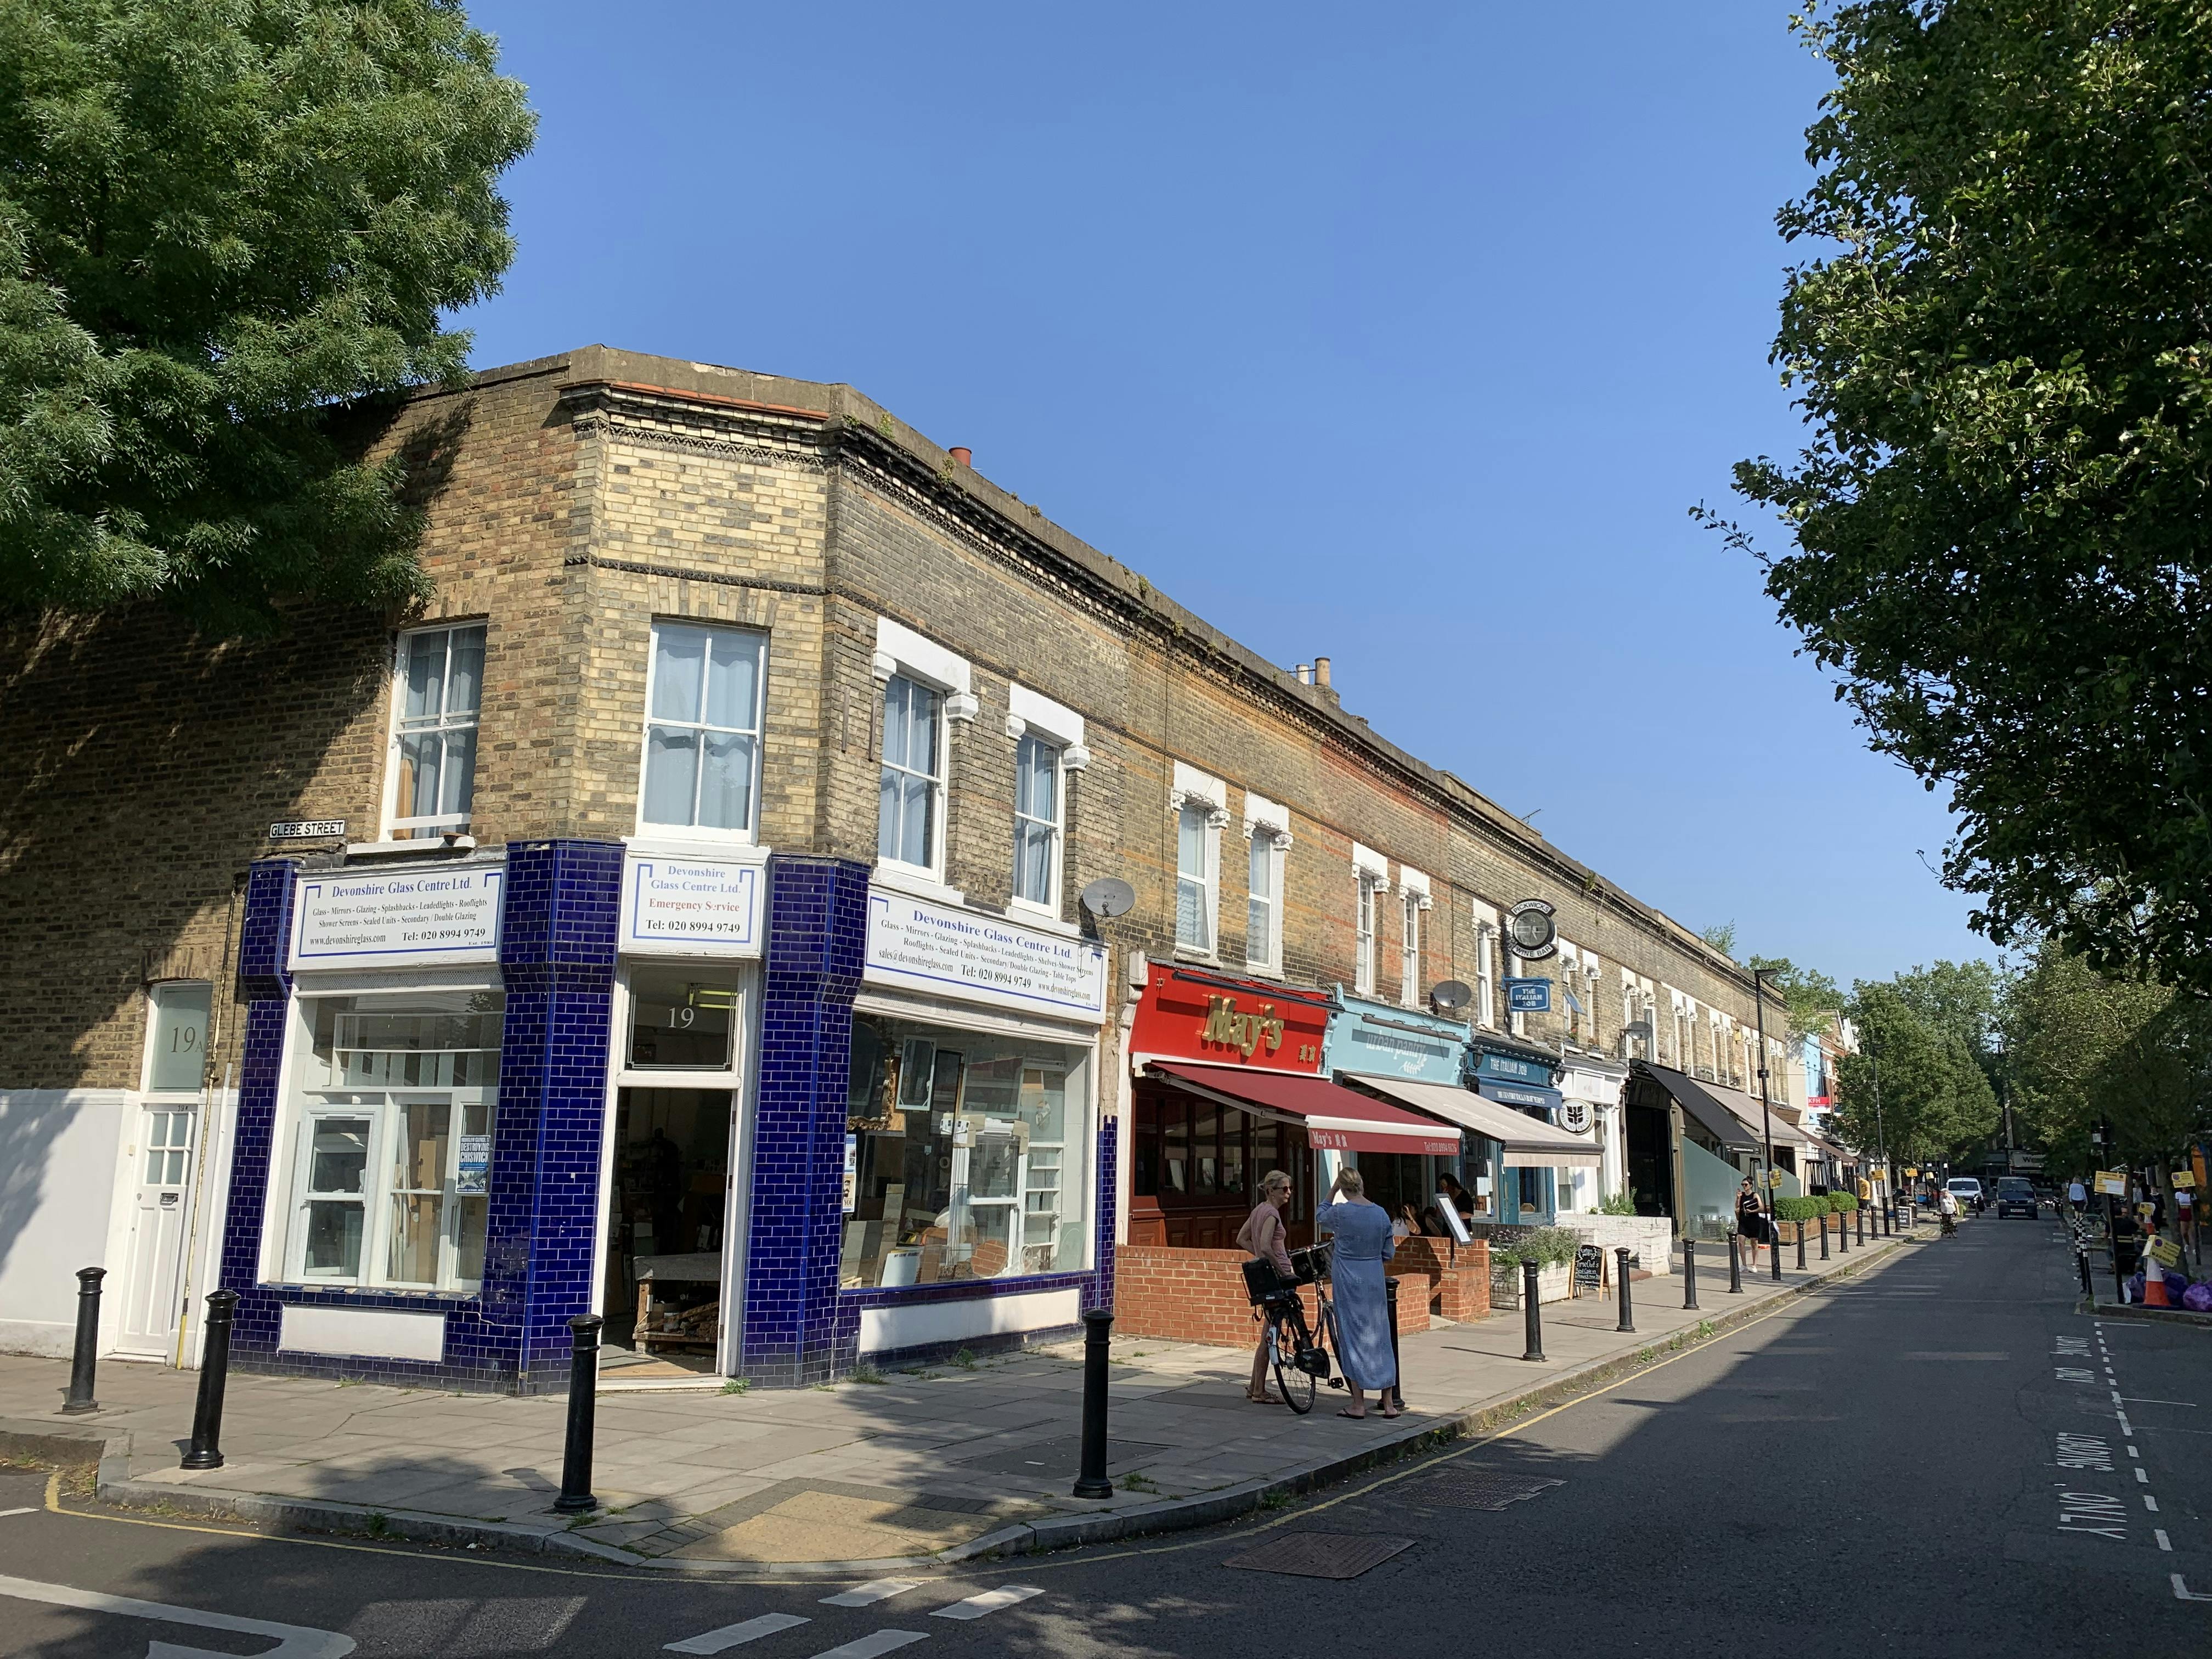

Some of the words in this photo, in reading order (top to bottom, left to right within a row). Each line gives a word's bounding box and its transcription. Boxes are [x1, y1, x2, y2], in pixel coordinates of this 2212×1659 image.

[272, 824, 302, 836] GLEBE
[304, 822, 343, 834] STREET
[668, 865, 725, 878] Devonshire
[332, 883, 385, 898] Devonshire
[388, 882, 414, 894] Glass
[417, 879, 450, 892] Centre
[452, 877, 472, 890] Ltd.
[651, 879, 679, 890] Glass
[682, 881, 717, 892] Centre
[720, 883, 741, 893] Ltd.
[313, 908, 326, 916] Glass
[356, 905, 376, 914] Glazing
[381, 902, 415, 914] Splashbacks
[420, 900, 454, 910] Leadedlights
[459, 898, 487, 908] Rooflights
[649, 898, 703, 912] Emergency
[705, 901, 740, 912] Service
[1513, 902, 1550, 913] PICKWICKS
[401, 915, 428, 924] Secondary
[434, 913, 453, 921] Double
[455, 911, 476, 921] Glazing
[646, 919, 664, 930] Tel:
[668, 921, 686, 930] 020
[690, 922, 713, 932] 8994
[716, 923, 740, 933] 9749
[310, 934, 386, 946] www.devonshireglass.com
[402, 932, 418, 941] Tel:
[421, 930, 437, 940] 020
[439, 929, 461, 939] 8994
[464, 928, 486, 937] 9749
[913, 910, 980, 936] Devonshire
[984, 928, 1013, 944] Glass
[1017, 936, 1051, 953] Centre
[1054, 945, 1072, 959] Ltd.
[881, 919, 899, 930] Glass
[906, 925, 929, 938] Mirrors
[935, 932, 957, 945] Glazing
[963, 939, 997, 953] Splashbacks
[1002, 947, 1034, 962] Leadedlights
[1076, 966, 1093, 976] Screens
[1516, 947, 1534, 957] WINE
[1537, 946, 1551, 956] BAR
[904, 937, 934, 951] Rooflights
[939, 946, 958, 957] Sealed
[1029, 965, 1048, 978] Glazing
[1052, 970, 1064, 980] Table
[1065, 973, 1076, 983] Tops
[961, 964, 976, 978] Tel:
[979, 968, 992, 981] 020
[995, 971, 1011, 985] 8994
[1014, 975, 1031, 989] 9749
[1038, 982, 1091, 1001] www.devonshireglass.com
[667, 1006, 695, 1029] 19
[1202, 994, 1284, 1057] May's
[1366, 1030, 1395, 1053] urban
[1393, 1039, 1428, 1064] pantry
[1491, 1057, 1500, 1071] THE
[1500, 1059, 1518, 1074] ITALIAN
[1518, 1064, 1527, 1075] JOB
[461, 1143, 489, 1151] DESTROYING
[1312, 1131, 1332, 1147] May's
[460, 1152, 489, 1163] CHISWICK
[2054, 1367, 2096, 1384] ONLY
[2056, 1432, 2115, 1472] LOADING
[2057, 1492, 2128, 1539] ONLY
